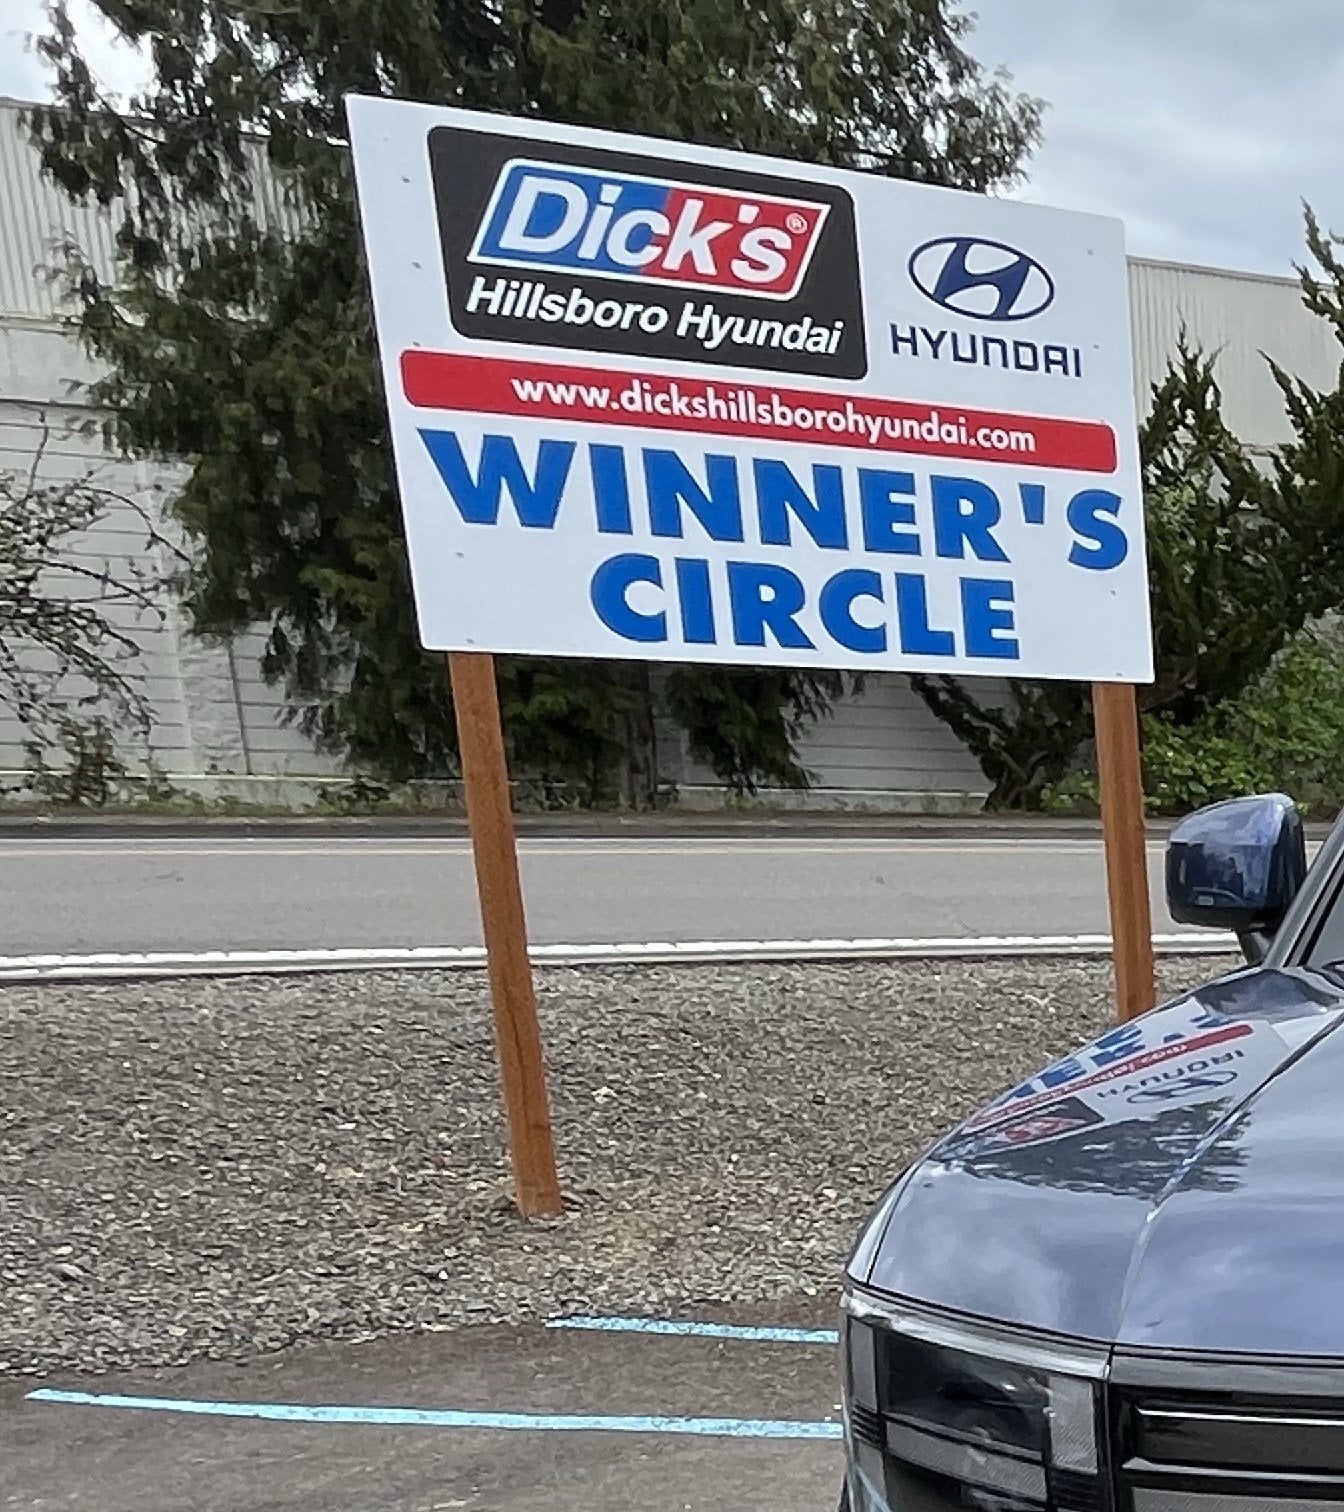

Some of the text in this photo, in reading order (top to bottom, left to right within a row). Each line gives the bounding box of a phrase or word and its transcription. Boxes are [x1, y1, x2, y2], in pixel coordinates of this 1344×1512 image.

[497, 175, 794, 286] Dick's
[465, 275, 846, 357] Hillsboro Hyundai
[890, 322, 1083, 379] HYUNDAI
[511, 377, 1036, 455] www.dickshillsborohyundai.com
[417, 428, 1129, 572] WINNER'S
[590, 552, 1021, 661] CIRCLE
